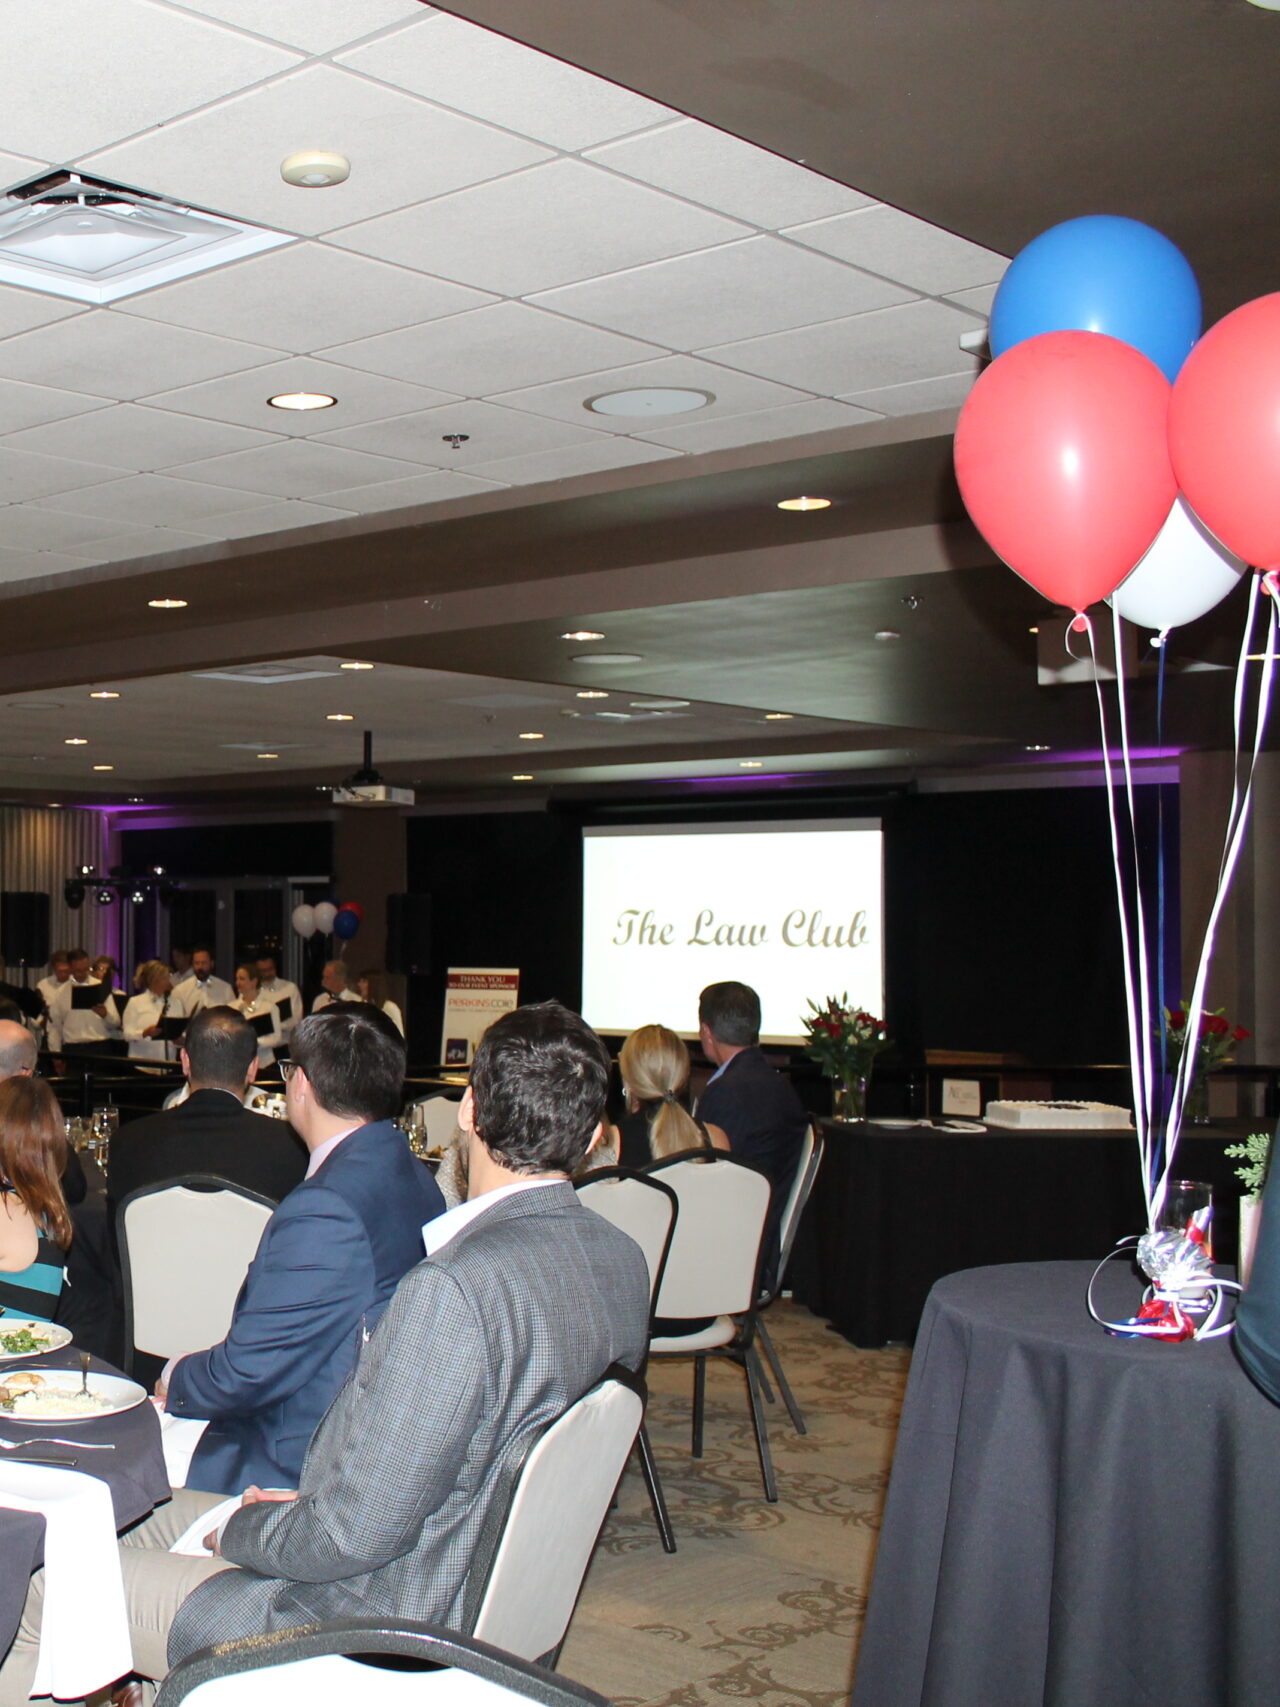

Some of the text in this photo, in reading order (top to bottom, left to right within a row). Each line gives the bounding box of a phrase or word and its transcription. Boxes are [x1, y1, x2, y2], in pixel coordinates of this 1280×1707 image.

[612, 909, 869, 949] The Law Club
